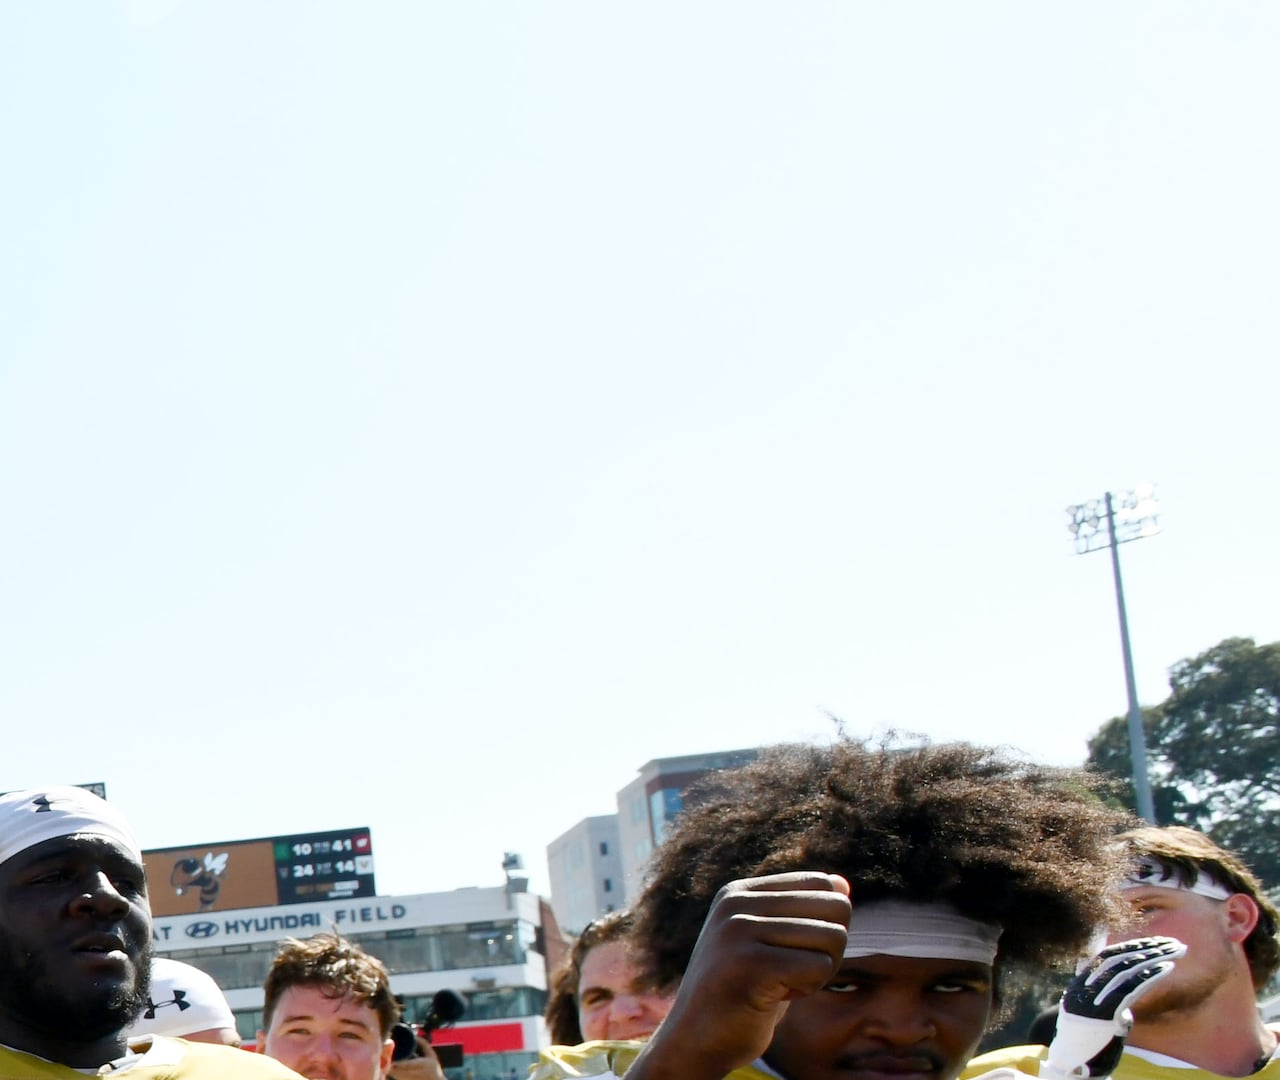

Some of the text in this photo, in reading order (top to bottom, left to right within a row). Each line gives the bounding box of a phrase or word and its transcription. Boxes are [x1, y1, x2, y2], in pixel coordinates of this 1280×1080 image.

[292, 843, 312, 856] 10
[332, 839, 352, 851] 41
[225, 912, 320, 934] HYUNDAI
[336, 905, 406, 924] FIELD
